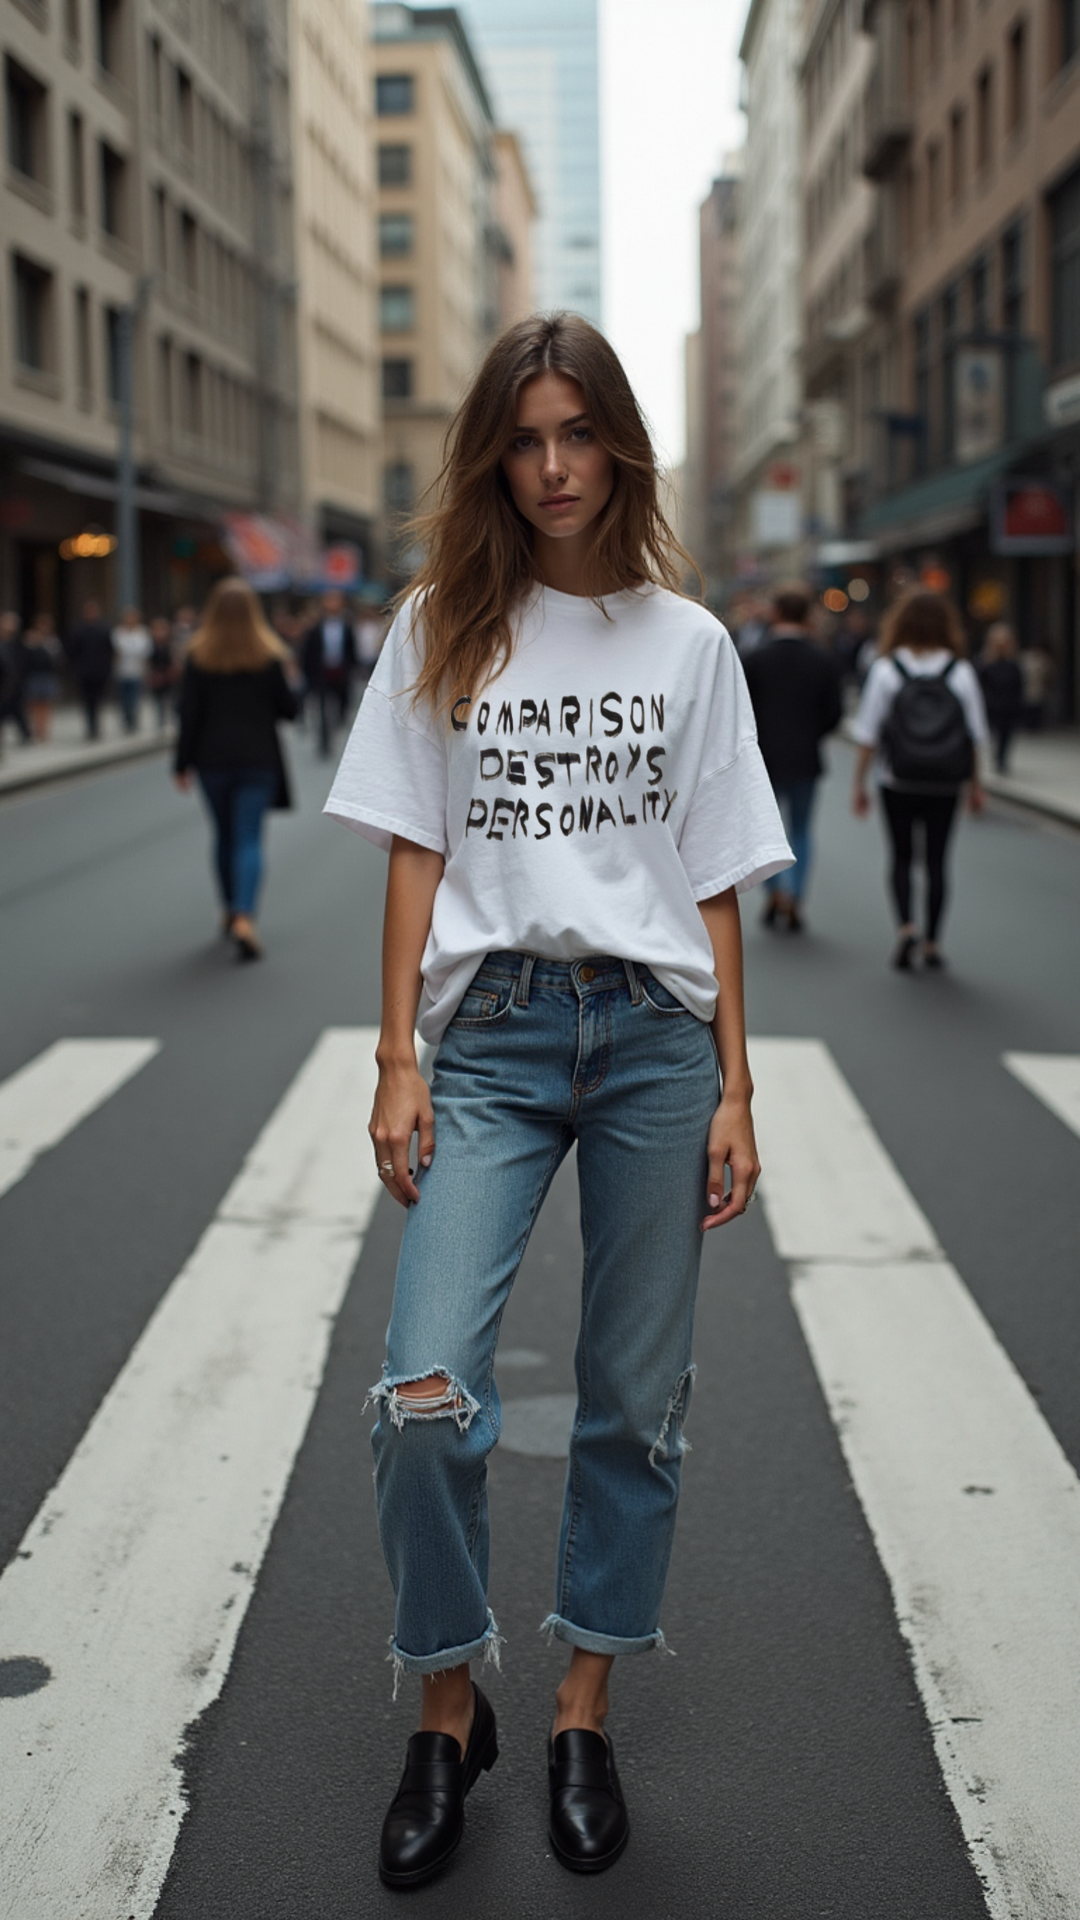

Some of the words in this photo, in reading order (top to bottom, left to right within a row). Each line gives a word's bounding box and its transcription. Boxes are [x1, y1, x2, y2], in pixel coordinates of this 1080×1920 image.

[451, 691, 664, 738] COMPARISON
[479, 742, 667, 789] DESTROYS
[465, 788, 678, 841] PERSONALITY
